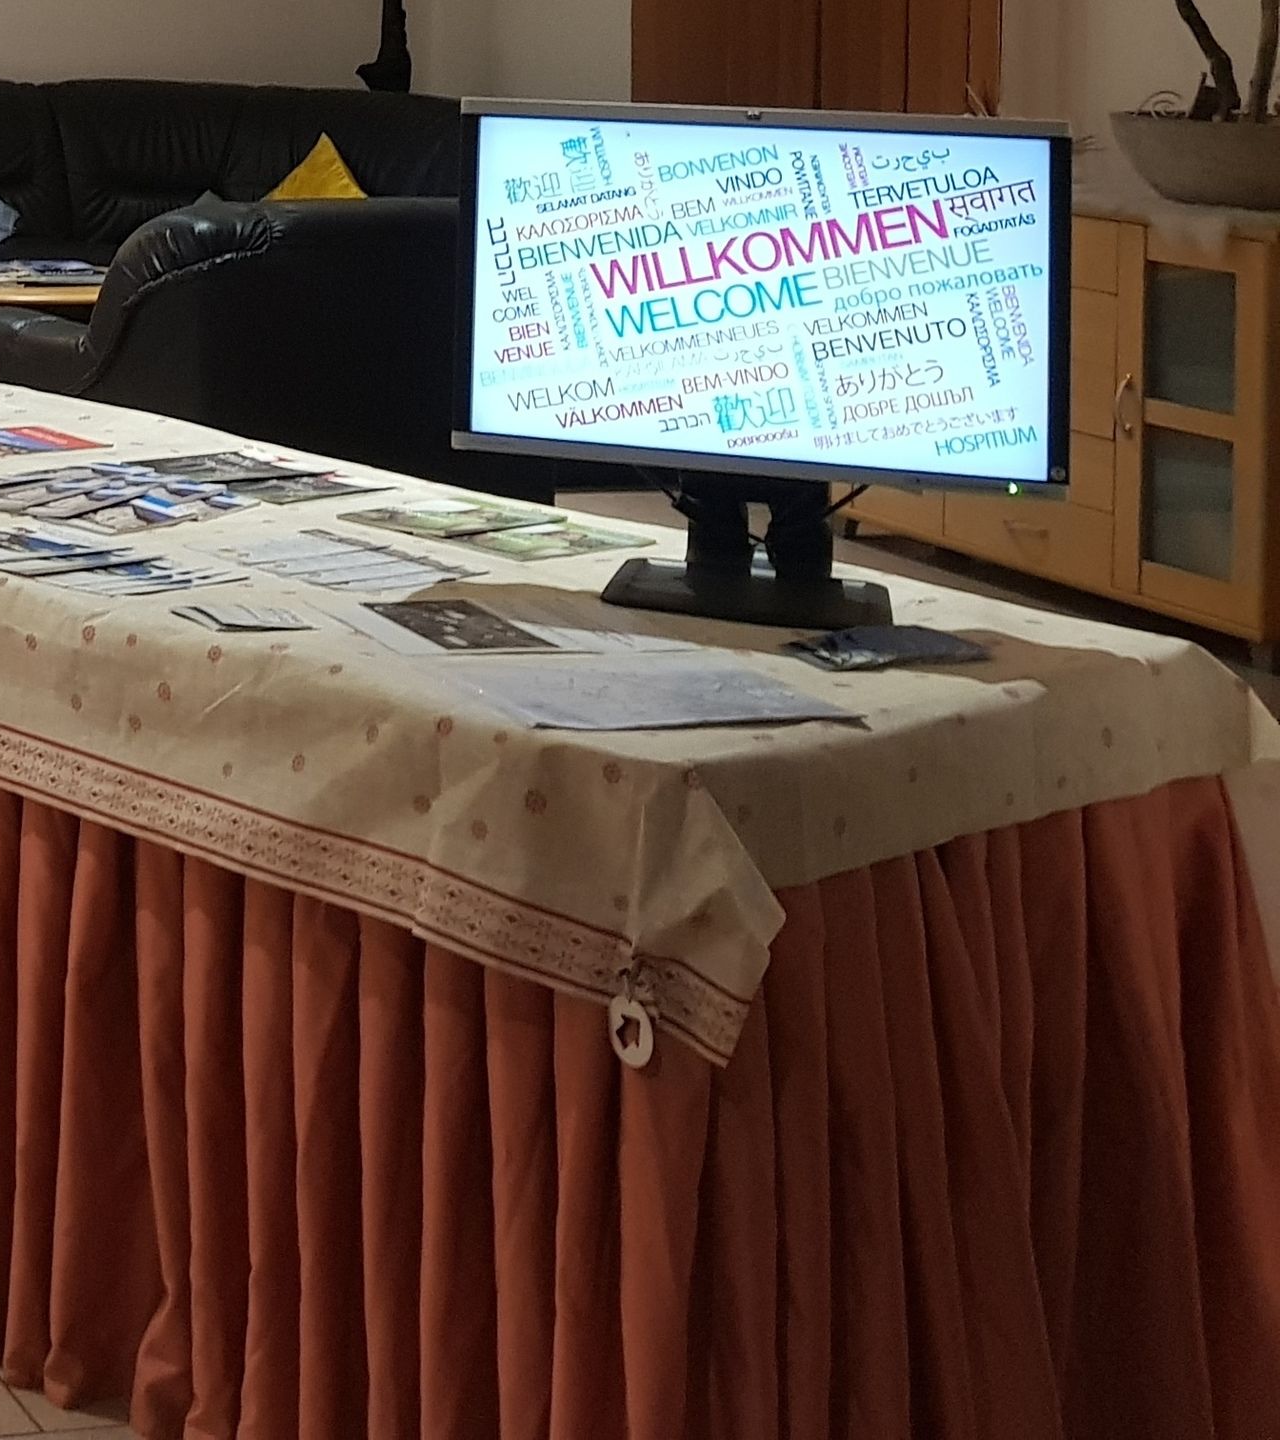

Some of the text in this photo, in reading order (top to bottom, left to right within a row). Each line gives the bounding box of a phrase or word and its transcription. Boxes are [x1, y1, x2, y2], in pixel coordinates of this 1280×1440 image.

[658, 144, 780, 183] BONVENON
[716, 167, 783, 194] VINDO
[536, 186, 637, 214] SELAMAT DATANG
[848, 166, 1000, 210] TERVETULOA
[671, 197, 717, 220] BEM
[686, 203, 799, 237] VELKOMNIR
[517, 220, 683, 270] BIENVENIDA
[589, 198, 950, 299] WILLKOMMEN
[822, 238, 993, 290] BIENVENUE
[502, 287, 537, 303] WEL
[605, 271, 823, 338] WELCOME
[834, 263, 1044, 314] добро пожаловать
[492, 302, 542, 323] COME
[803, 301, 928, 337] VELKOMMEN
[509, 321, 551, 342] BIEN
[811, 317, 967, 361] BENVENUTO
[494, 341, 555, 364] VENUE
[507, 376, 615, 412] WELKOM
[681, 362, 789, 395] BEM-VINDO
[836, 359, 945, 398] ありがとう
[555, 394, 684, 429] VÄLKOMMEN
[843, 386, 975, 425] ДОБРЕ ДОШЪЛ
[934, 425, 1038, 457] HOSPITIUM
